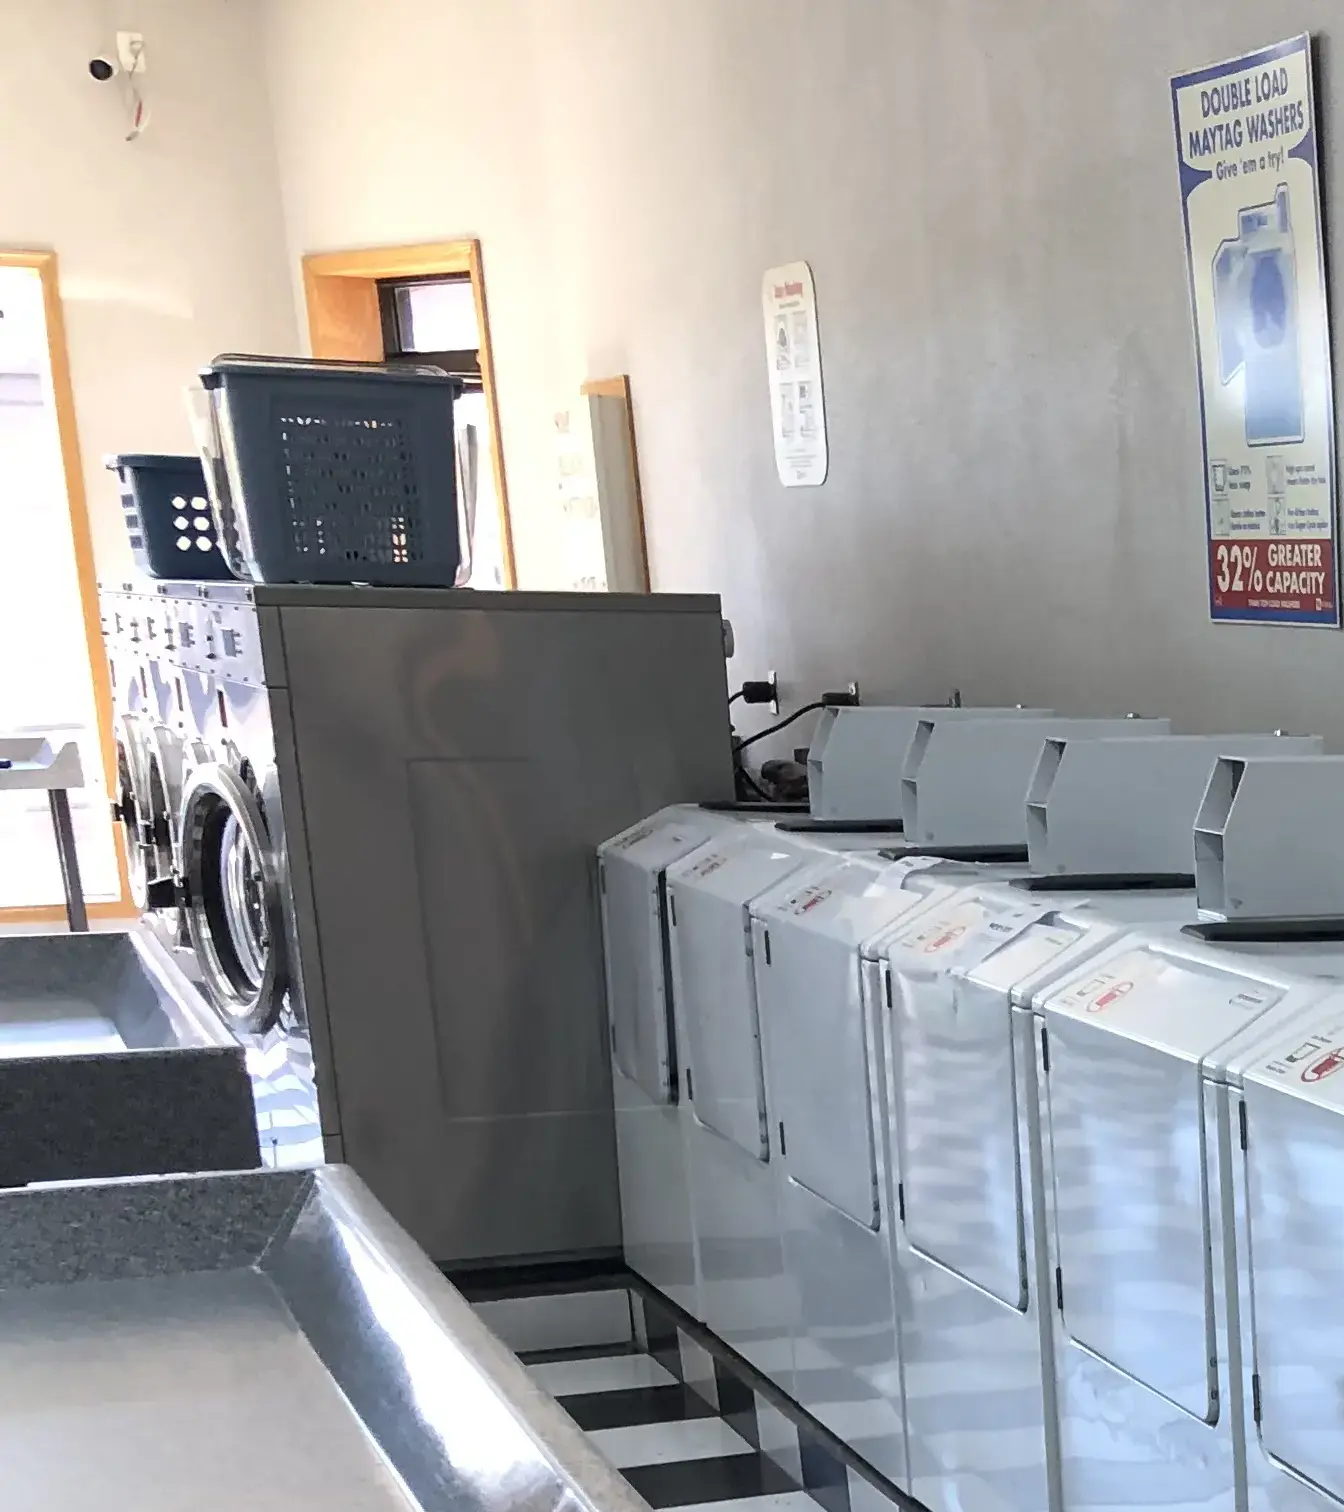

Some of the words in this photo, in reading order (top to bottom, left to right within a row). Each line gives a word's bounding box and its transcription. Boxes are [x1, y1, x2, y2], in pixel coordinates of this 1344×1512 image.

[1200, 81, 1251, 118] DOUBLE
[1255, 67, 1288, 103] LOAD
[1189, 122, 1243, 159] MAYTAG
[1246, 101, 1304, 144] WASHERS
[1216, 160, 1237, 180] Give
[1259, 156, 1266, 170] a
[1268, 146, 1285, 172] try!
[1217, 544, 1263, 592] 32%
[1268, 543, 1322, 567] GREATER
[1266, 571, 1325, 594] CAPACITY
